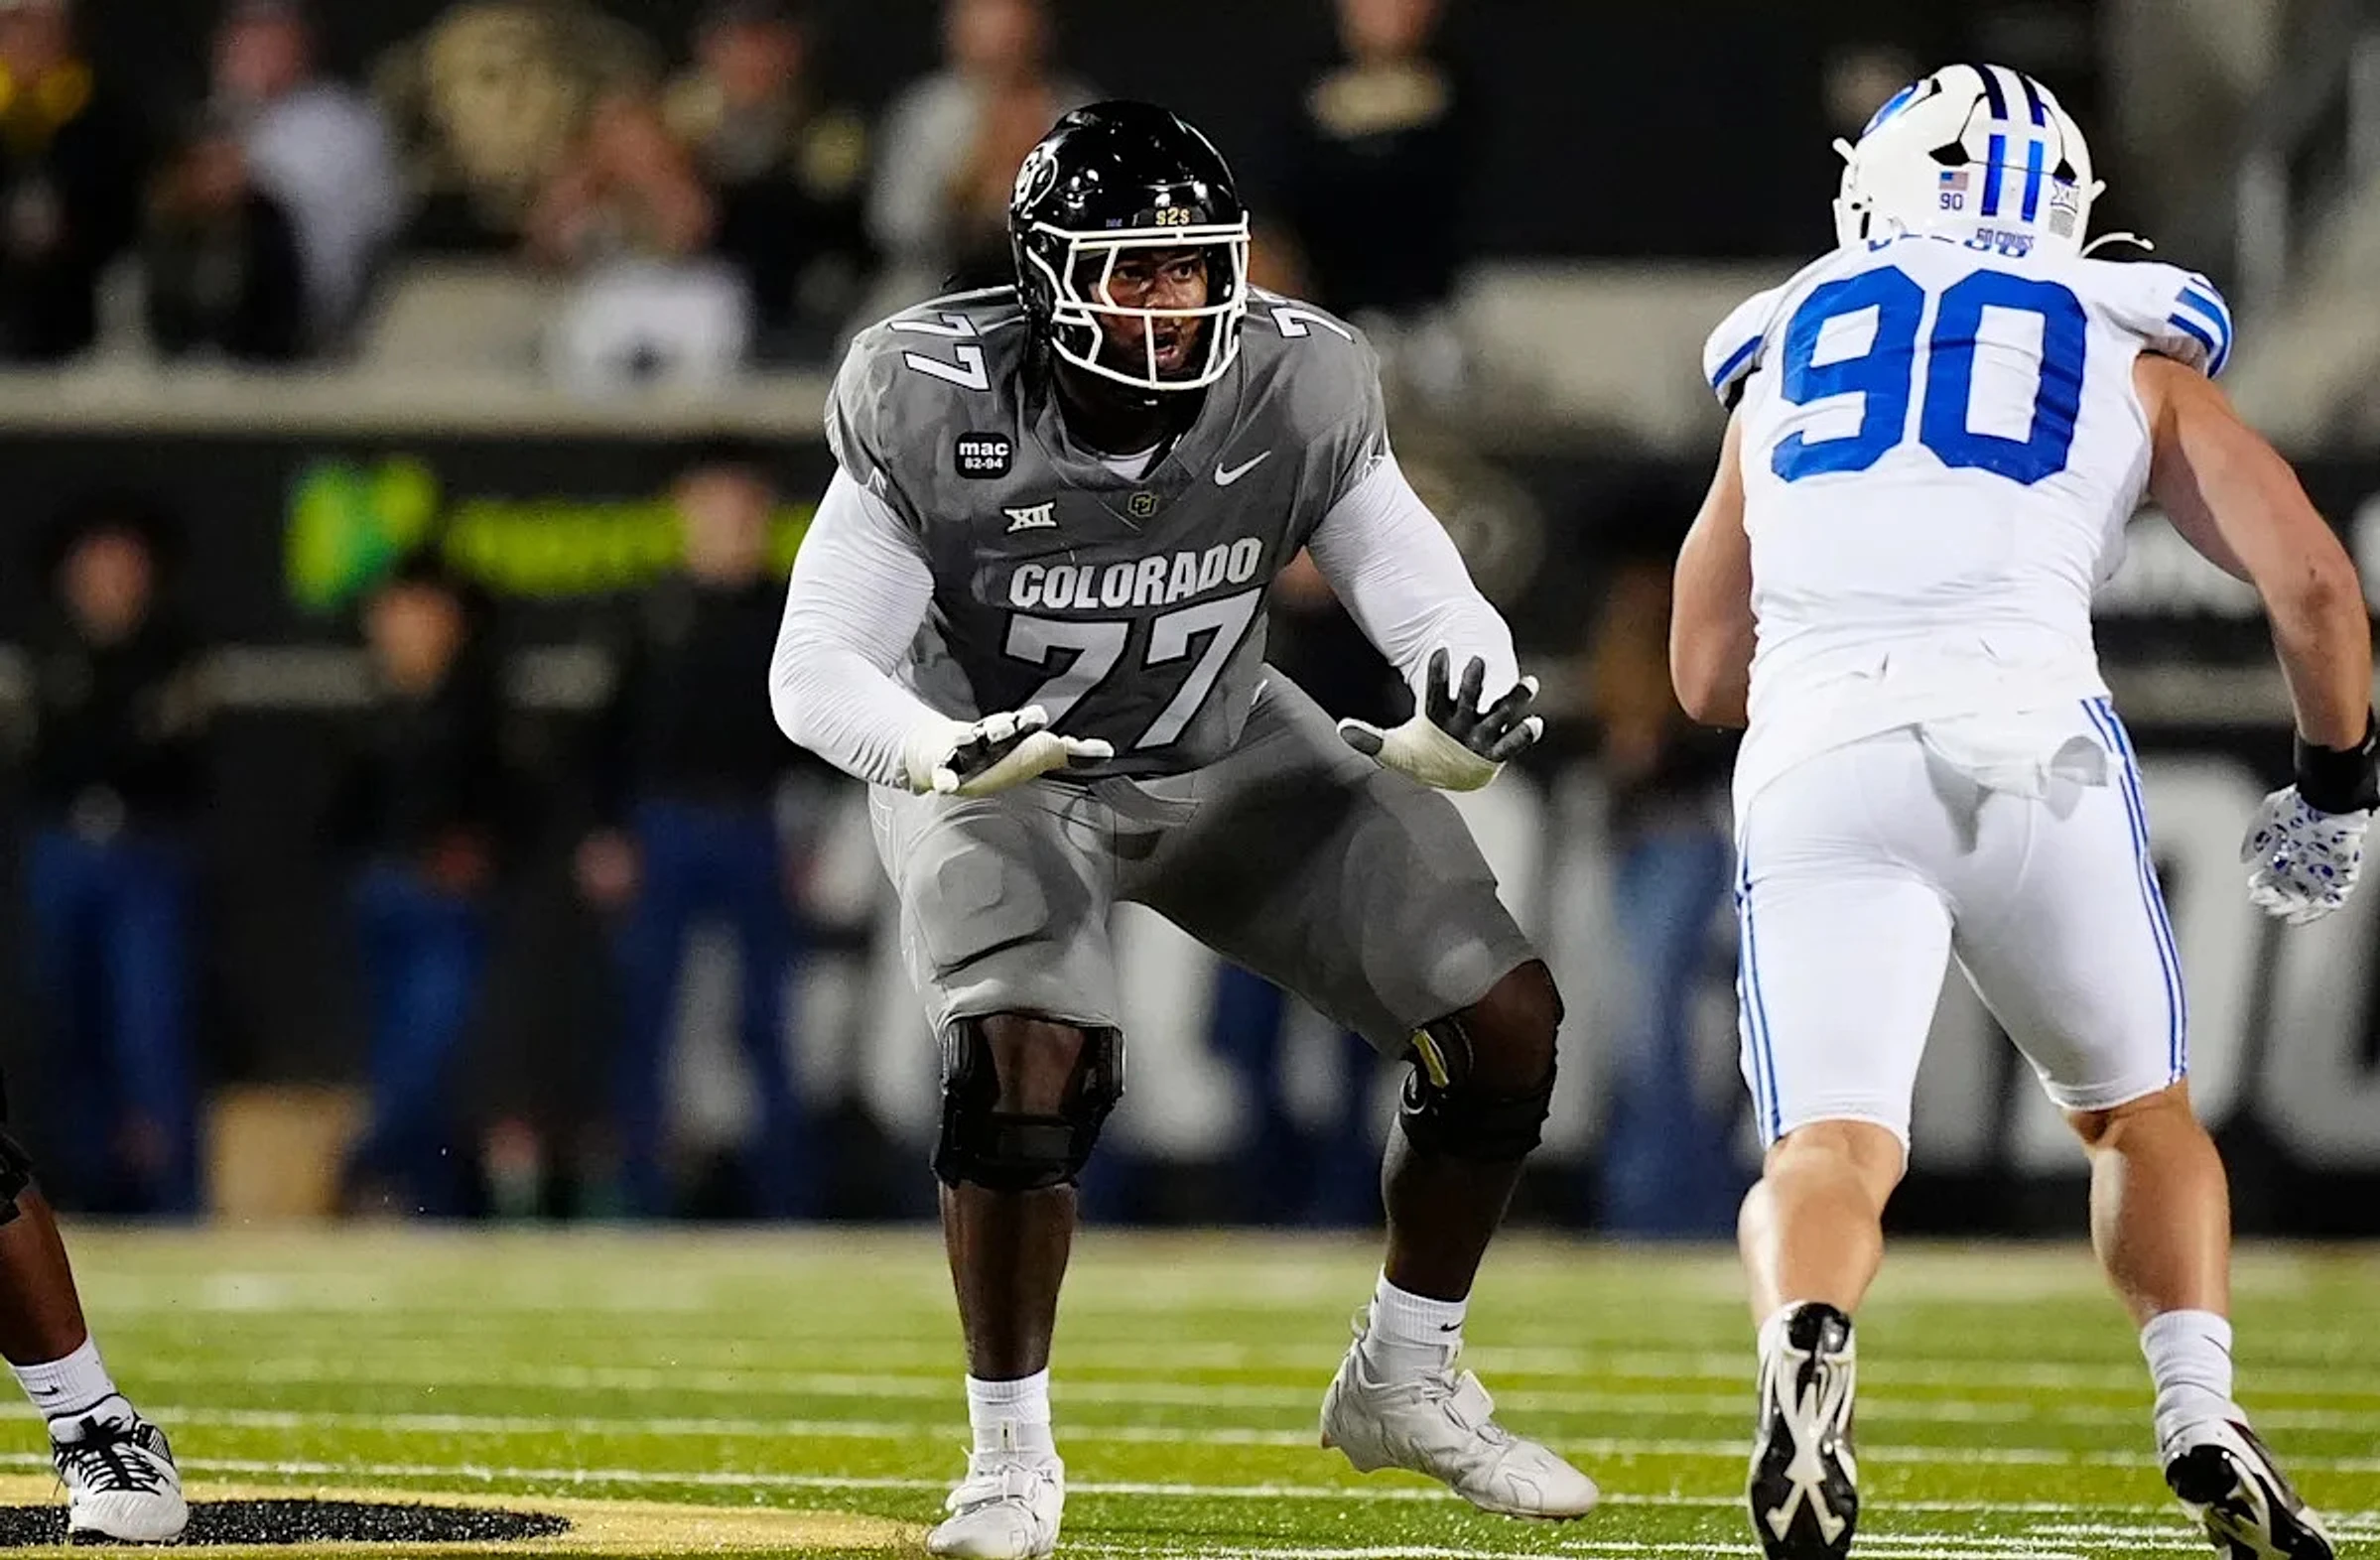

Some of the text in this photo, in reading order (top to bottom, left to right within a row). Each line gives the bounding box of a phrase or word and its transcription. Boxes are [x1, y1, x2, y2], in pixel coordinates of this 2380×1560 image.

[1939, 193, 1964, 211] 90
[887, 312, 992, 392] 77
[1771, 264, 2088, 486] 90
[958, 441, 1010, 456] mac
[964, 457, 1004, 470] 82-94
[1008, 537, 1264, 609] COLORADO
[1002, 585, 1267, 752] 77
